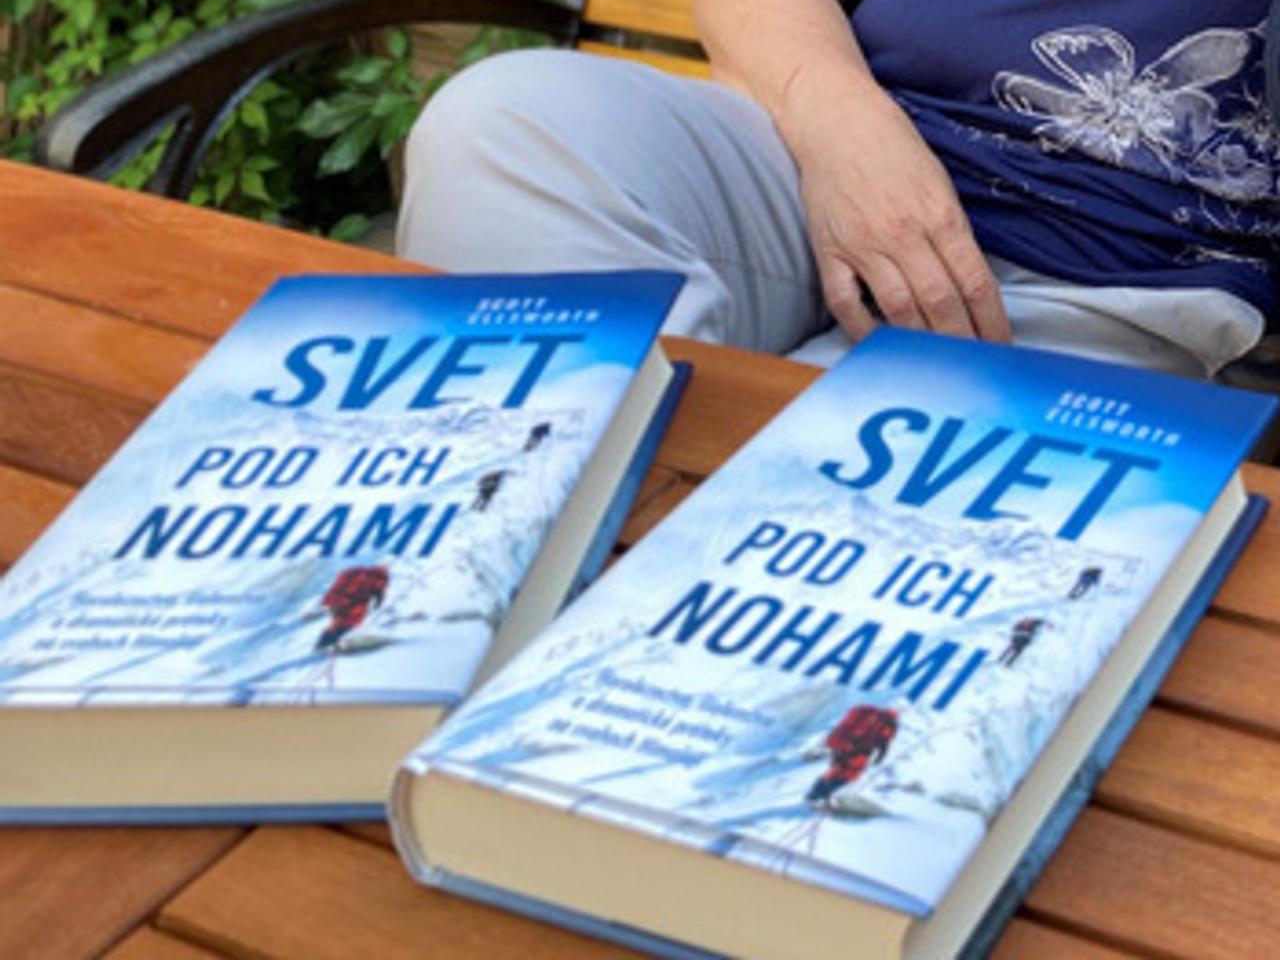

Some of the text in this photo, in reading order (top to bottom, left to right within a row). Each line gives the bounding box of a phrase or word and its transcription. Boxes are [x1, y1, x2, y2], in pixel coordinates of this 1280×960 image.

[475, 297, 547, 310] SCOTT
[251, 335, 586, 410] SVET
[1045, 407, 1182, 446] ELLSWORTH
[1058, 391, 1131, 417] SCOTT
[175, 446, 453, 489] POD ICH
[817, 406, 1161, 541] SVET
[113, 502, 461, 559] NOHAMI
[723, 520, 996, 618] POD ICH
[648, 581, 988, 713] NOHAMI
